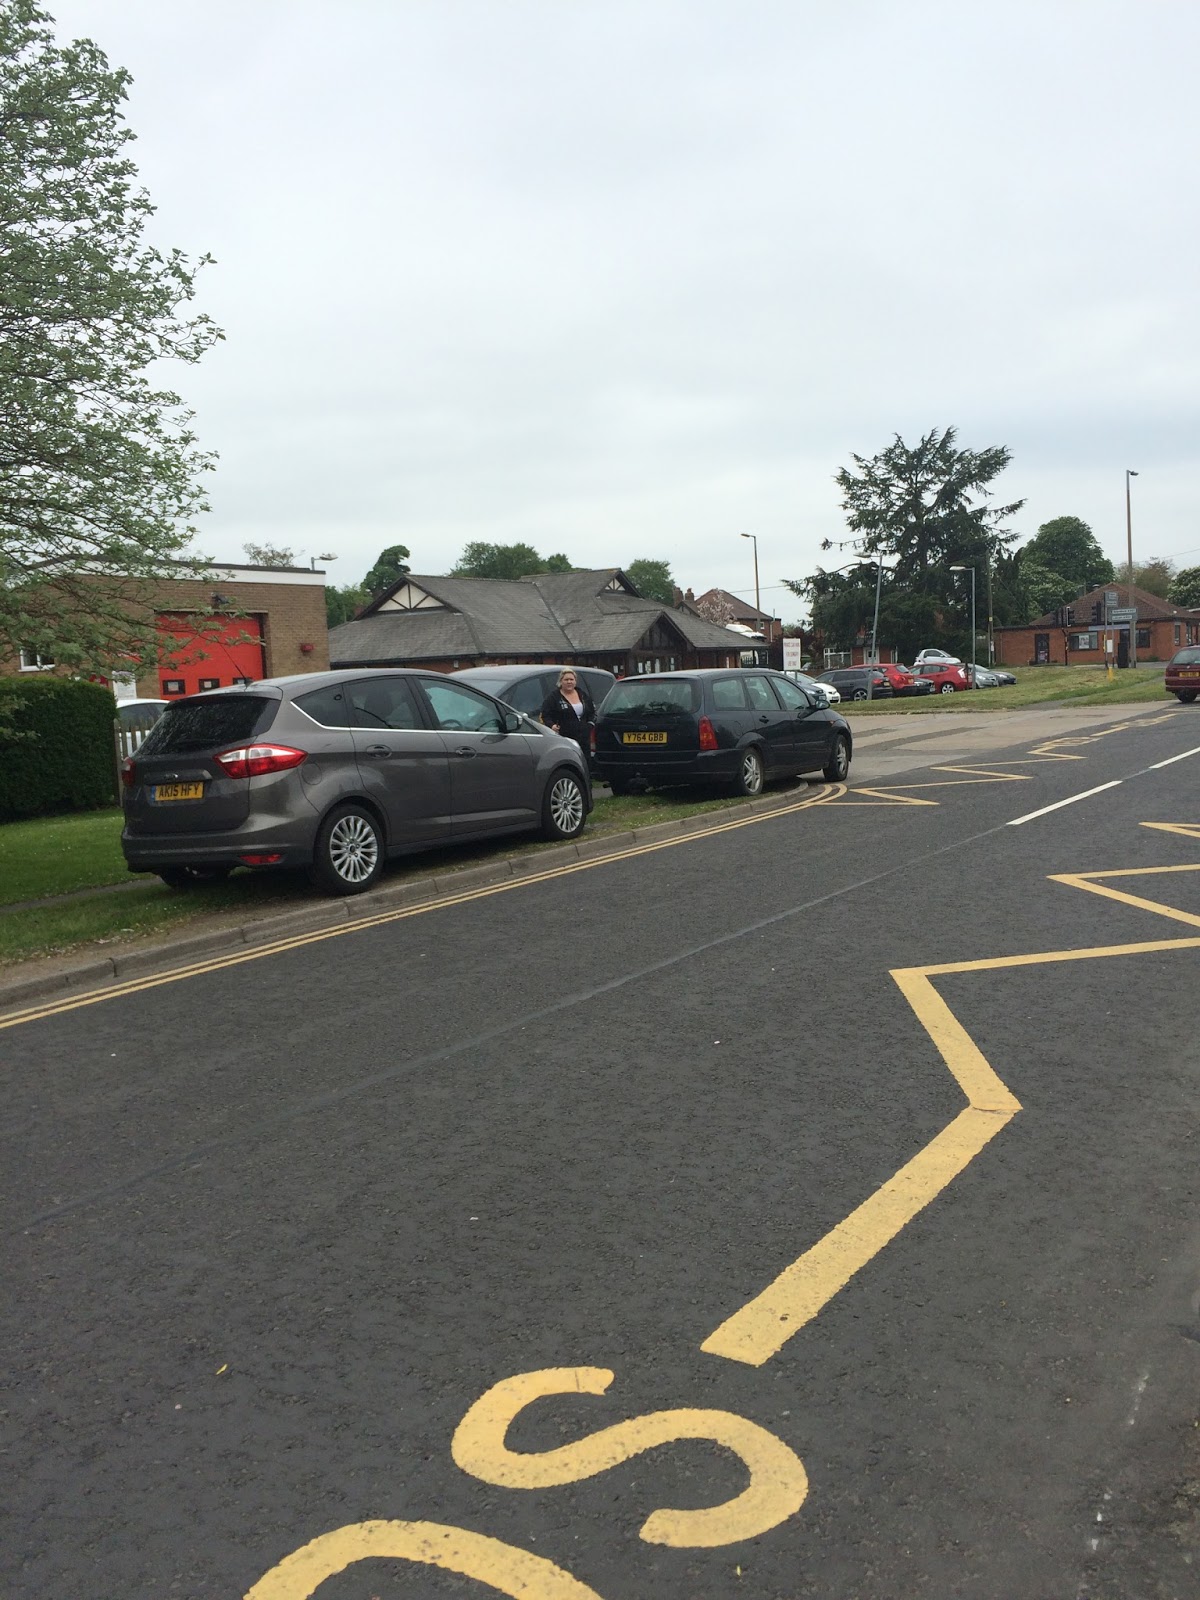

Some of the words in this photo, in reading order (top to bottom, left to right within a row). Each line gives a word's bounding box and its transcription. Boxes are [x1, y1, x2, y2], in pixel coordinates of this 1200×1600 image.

[627, 733, 647, 741] Y764
[649, 733, 664, 741] GBB
[158, 785, 179, 797] AK15
[181, 783, 199, 796] HFY
